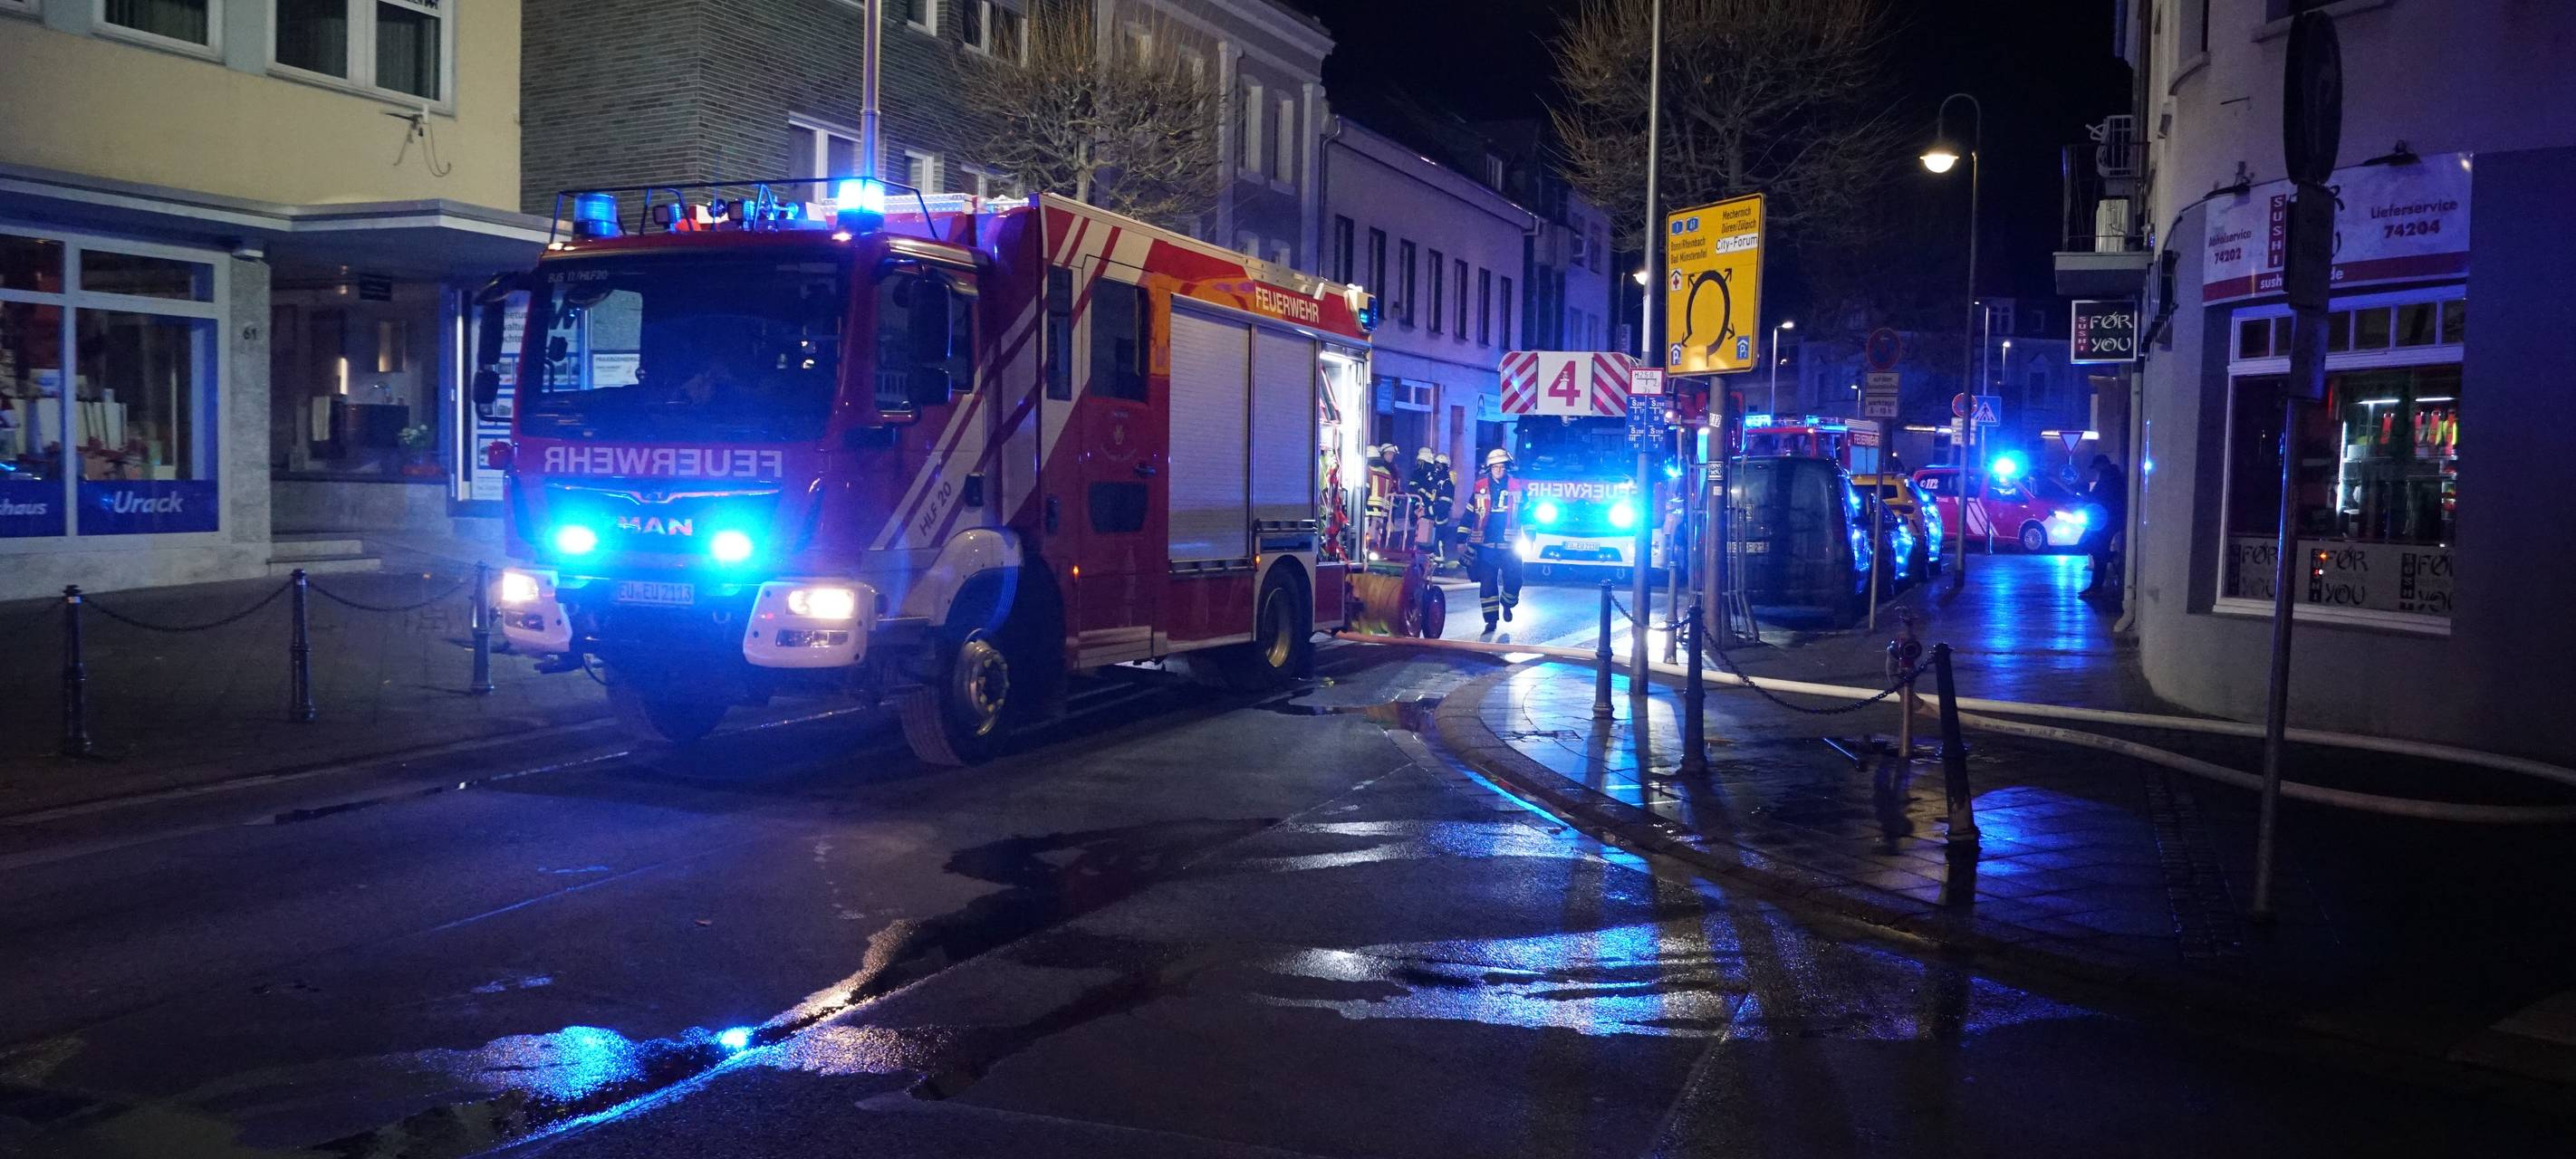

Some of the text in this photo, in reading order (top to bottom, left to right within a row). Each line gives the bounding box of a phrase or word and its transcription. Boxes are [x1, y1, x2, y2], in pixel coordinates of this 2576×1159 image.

[2371, 199, 2458, 219] Lieferservice
[2208, 228, 2252, 247] Abholservice
[2384, 219, 2440, 238] 74204
[1716, 235, 1758, 252] City-Forum
[2215, 248, 2242, 264] 74202
[1254, 286, 1320, 324] FEUERWEHR
[2091, 337, 2132, 352] YOU
[1548, 360, 1581, 407] 4
[113, 490, 183, 513] Urack
[919, 482, 951, 536] HLF 20
[617, 516, 693, 536] MAN
